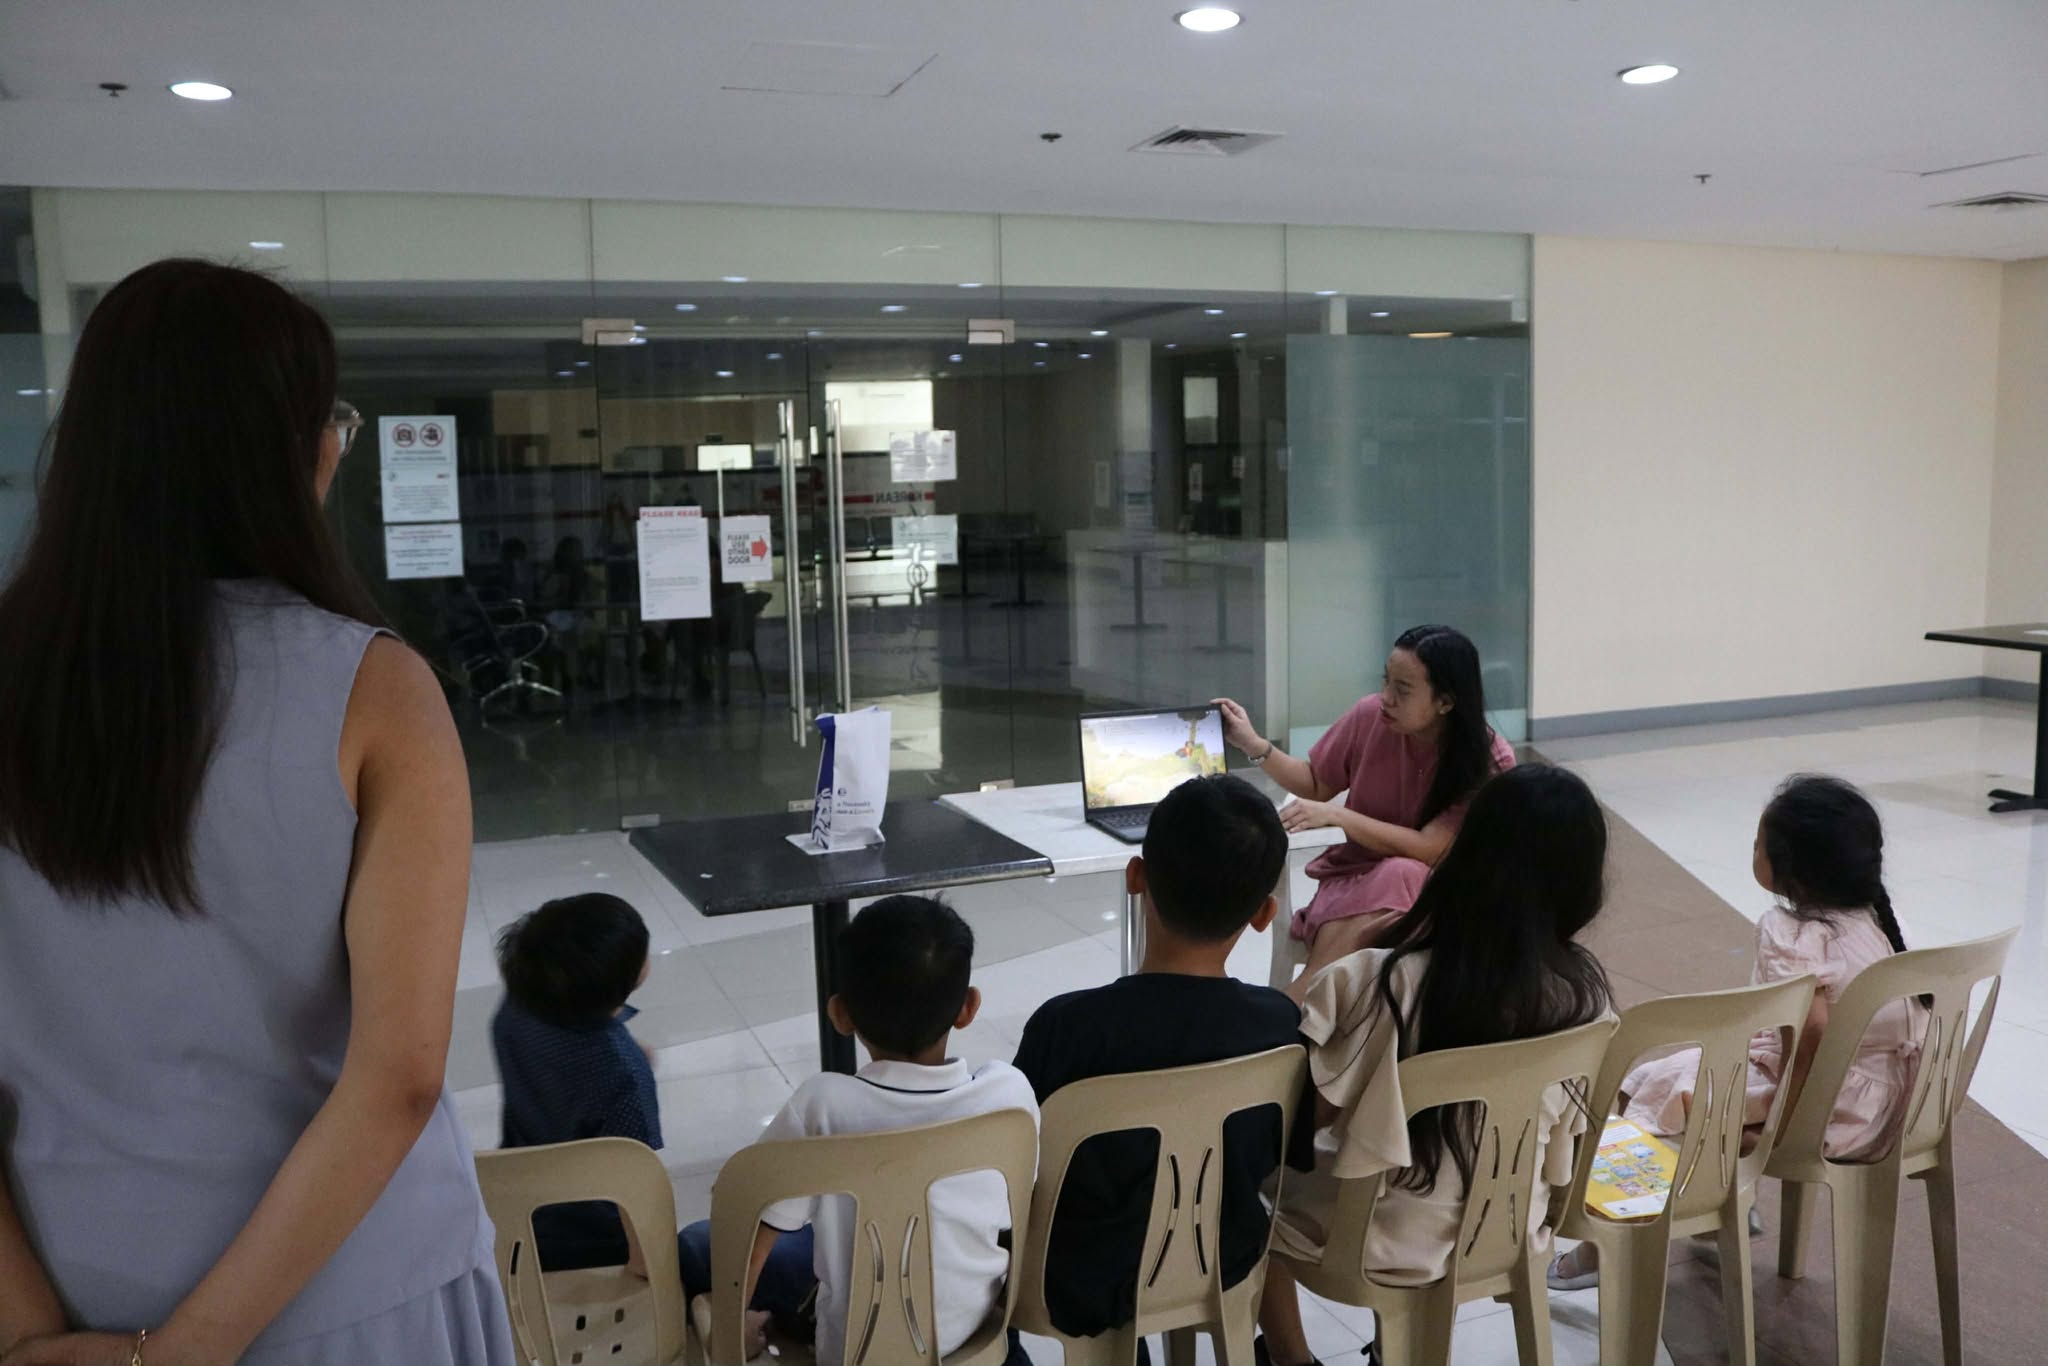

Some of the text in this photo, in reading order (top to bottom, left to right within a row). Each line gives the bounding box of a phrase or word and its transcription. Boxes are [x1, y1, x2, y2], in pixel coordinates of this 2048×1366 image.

[640, 510, 673, 518] PLEASE
[727, 548, 750, 556] OTHER
[727, 556, 750, 564] DOOR
